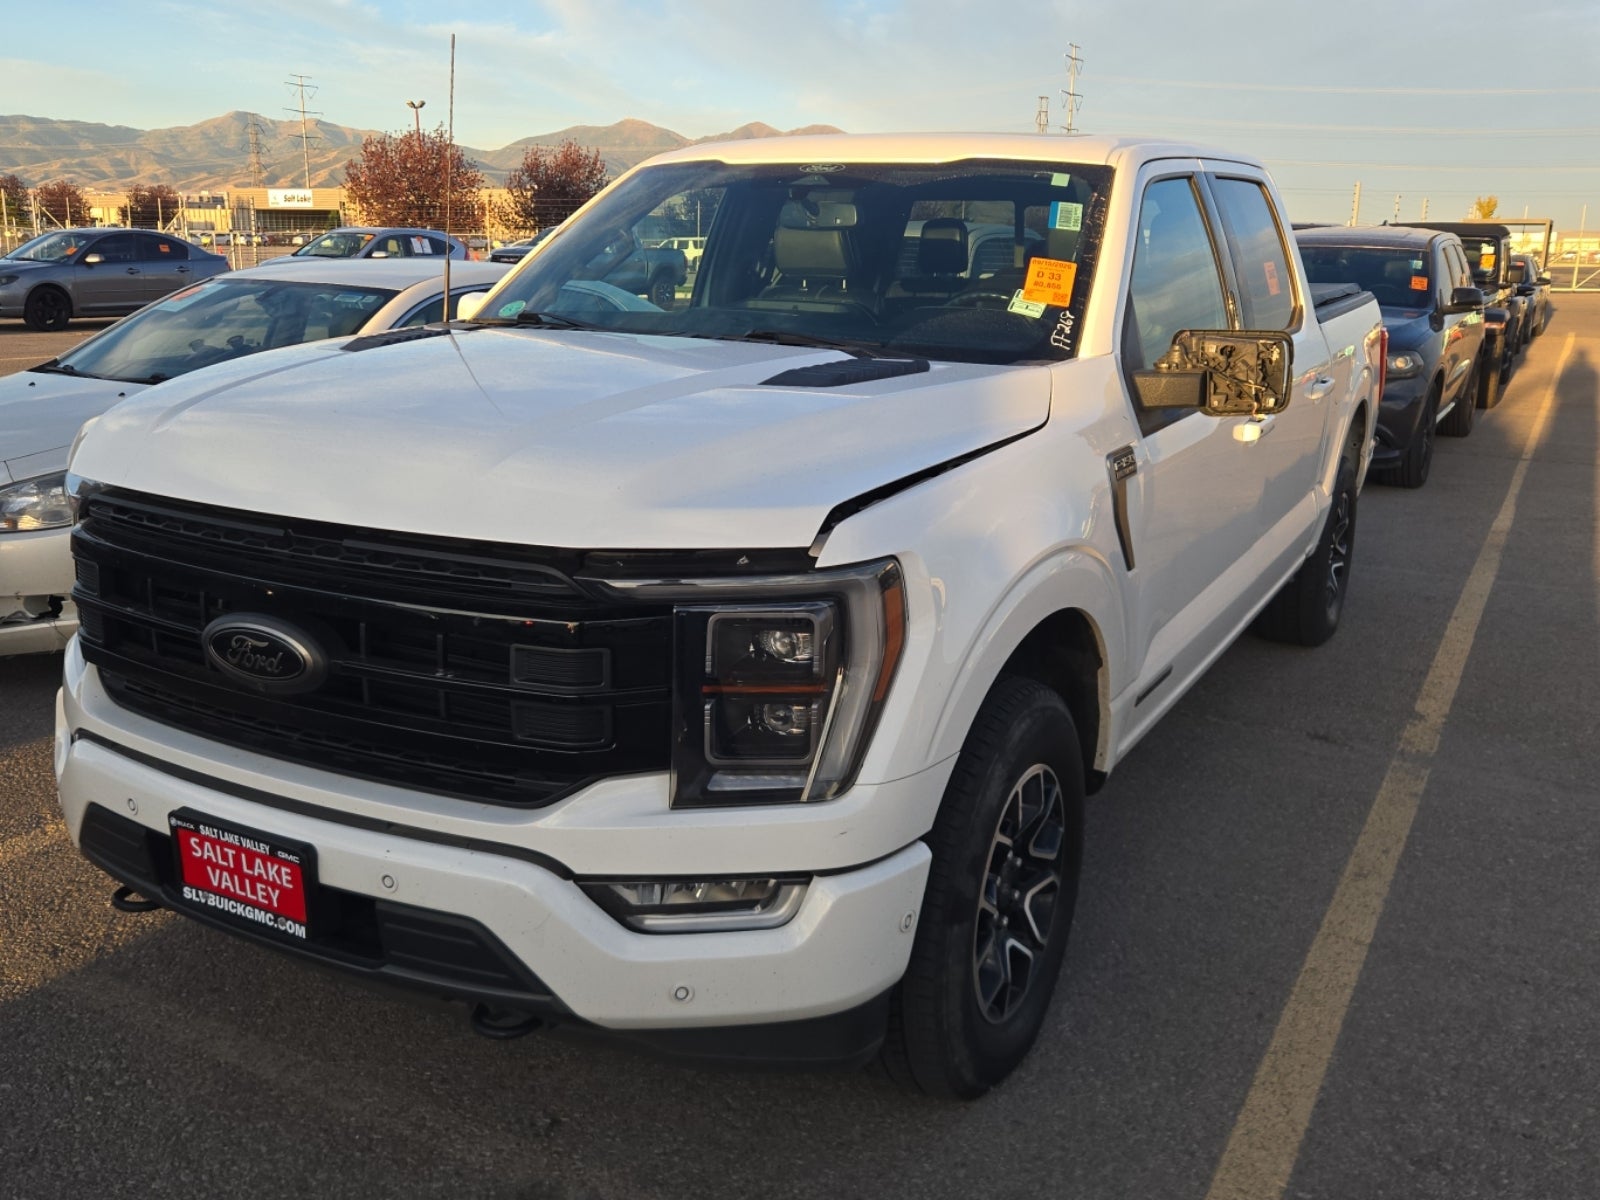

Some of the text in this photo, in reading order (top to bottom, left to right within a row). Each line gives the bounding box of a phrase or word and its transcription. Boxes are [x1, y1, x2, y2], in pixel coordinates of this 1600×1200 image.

[283, 194, 312, 203] Salt Lake
[1048, 272, 1062, 281] 33
[227, 634, 283, 673] Ford
[199, 824, 270, 855] SALT LAKE VALLEY
[189, 836, 294, 889] SALT LAKE
[277, 850, 300, 864] GMC
[206, 865, 281, 908] VALLEY
